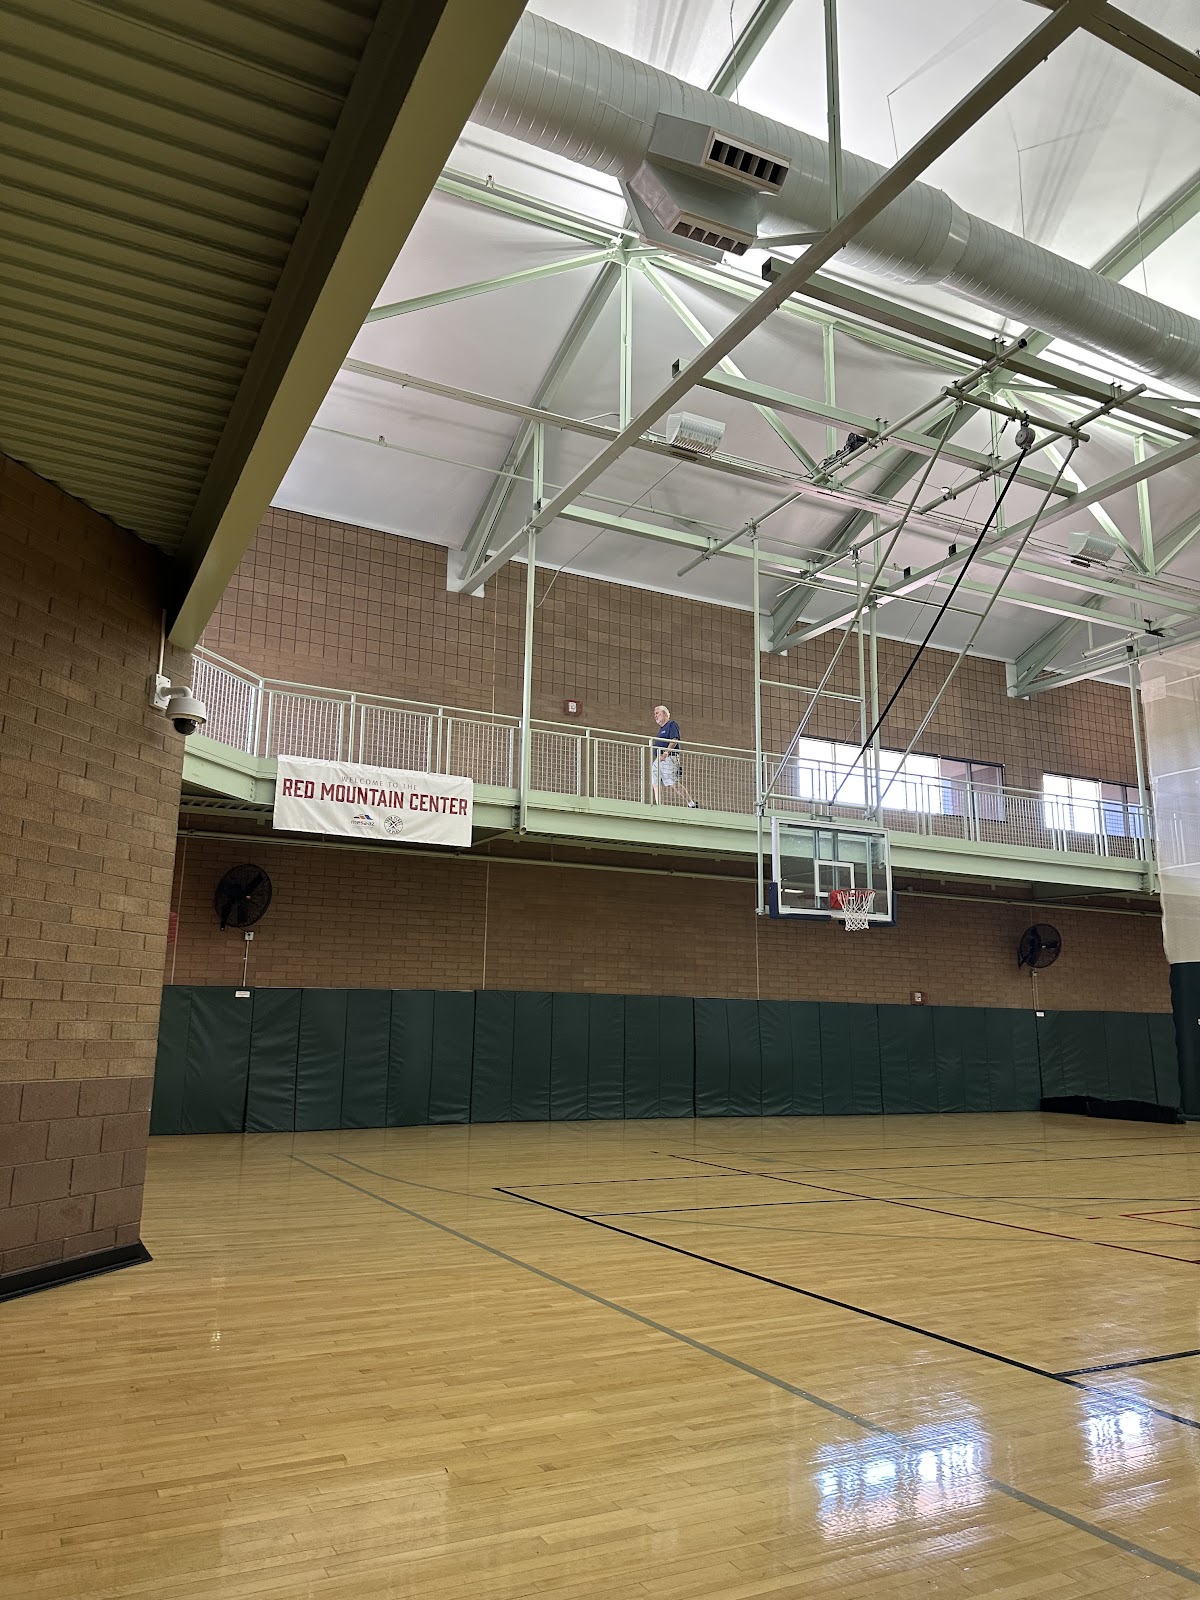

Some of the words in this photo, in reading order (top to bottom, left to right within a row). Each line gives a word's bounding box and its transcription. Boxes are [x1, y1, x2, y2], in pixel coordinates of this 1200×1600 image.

[341, 776, 383, 787] WELCOME
[388, 781, 399, 789] TO
[403, 783, 418, 791] THE
[282, 778, 315, 799] RED
[320, 782, 404, 810] MOUNTAIN
[409, 793, 468, 816] CENTER
